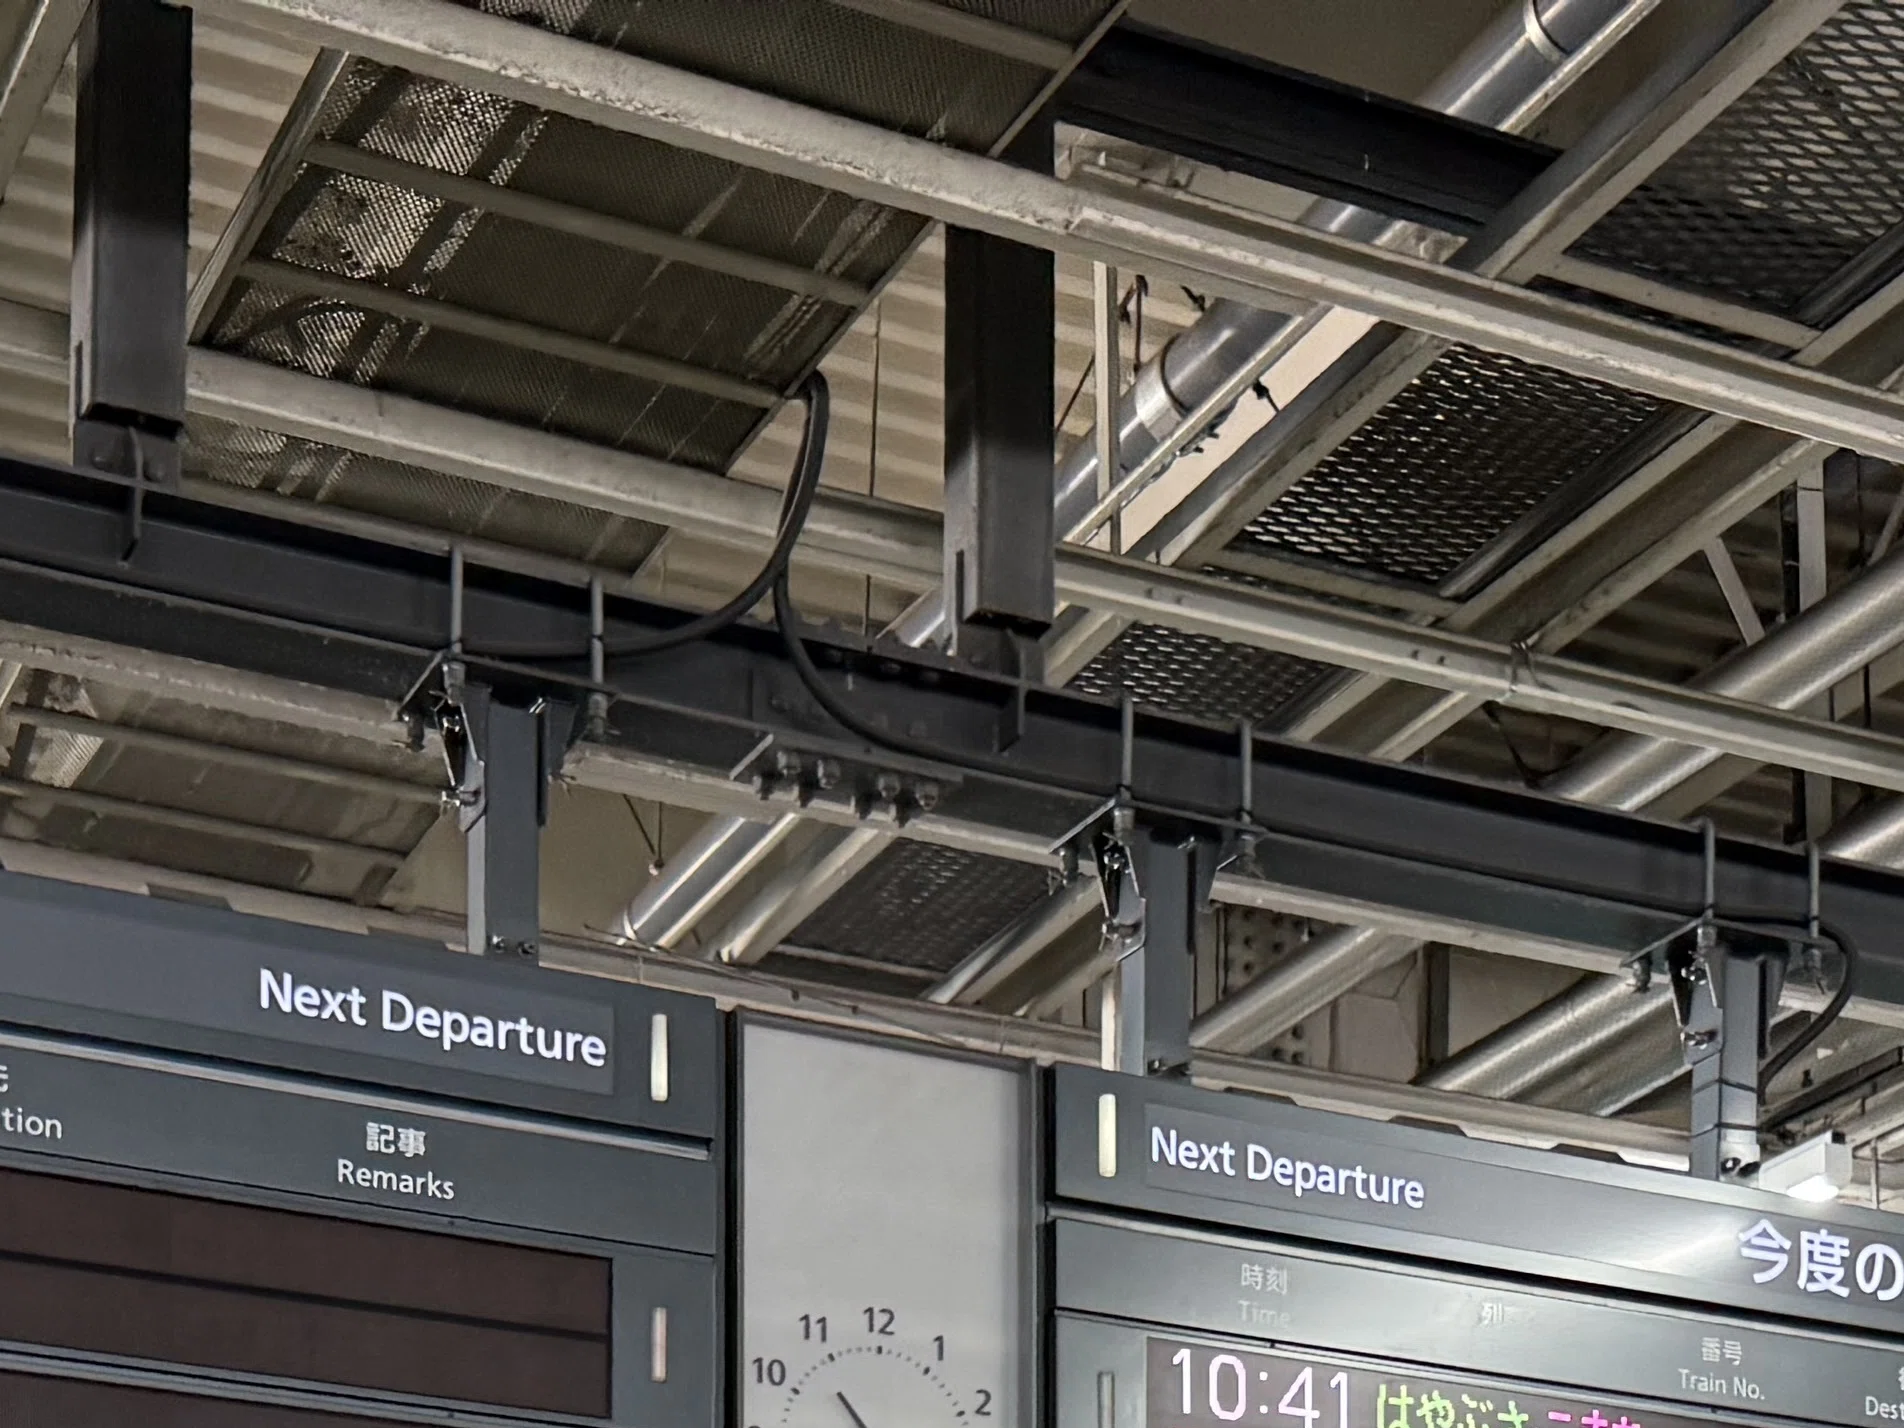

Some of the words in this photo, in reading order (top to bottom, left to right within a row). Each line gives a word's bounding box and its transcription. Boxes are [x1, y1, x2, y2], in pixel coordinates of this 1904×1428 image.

[259, 968, 367, 1026] Next
[381, 991, 607, 1068] Departure
[366, 1122, 426, 1157] 記事
[337, 1158, 455, 1200] Remarks
[1150, 1126, 1235, 1178] Next
[1247, 1144, 1425, 1210] Departure
[1241, 1263, 1288, 1295] 時刻
[798, 1314, 828, 1343] 11
[863, 1307, 895, 1335] 12
[1238, 1300, 1290, 1329] Time
[933, 1335, 945, 1361] 1
[1700, 1336, 1742, 1366] 番号
[752, 1357, 786, 1386] 10
[1678, 1369, 1725, 1396] Train
[1733, 1375, 1765, 1401] No.
[975, 1389, 992, 1416] 2
